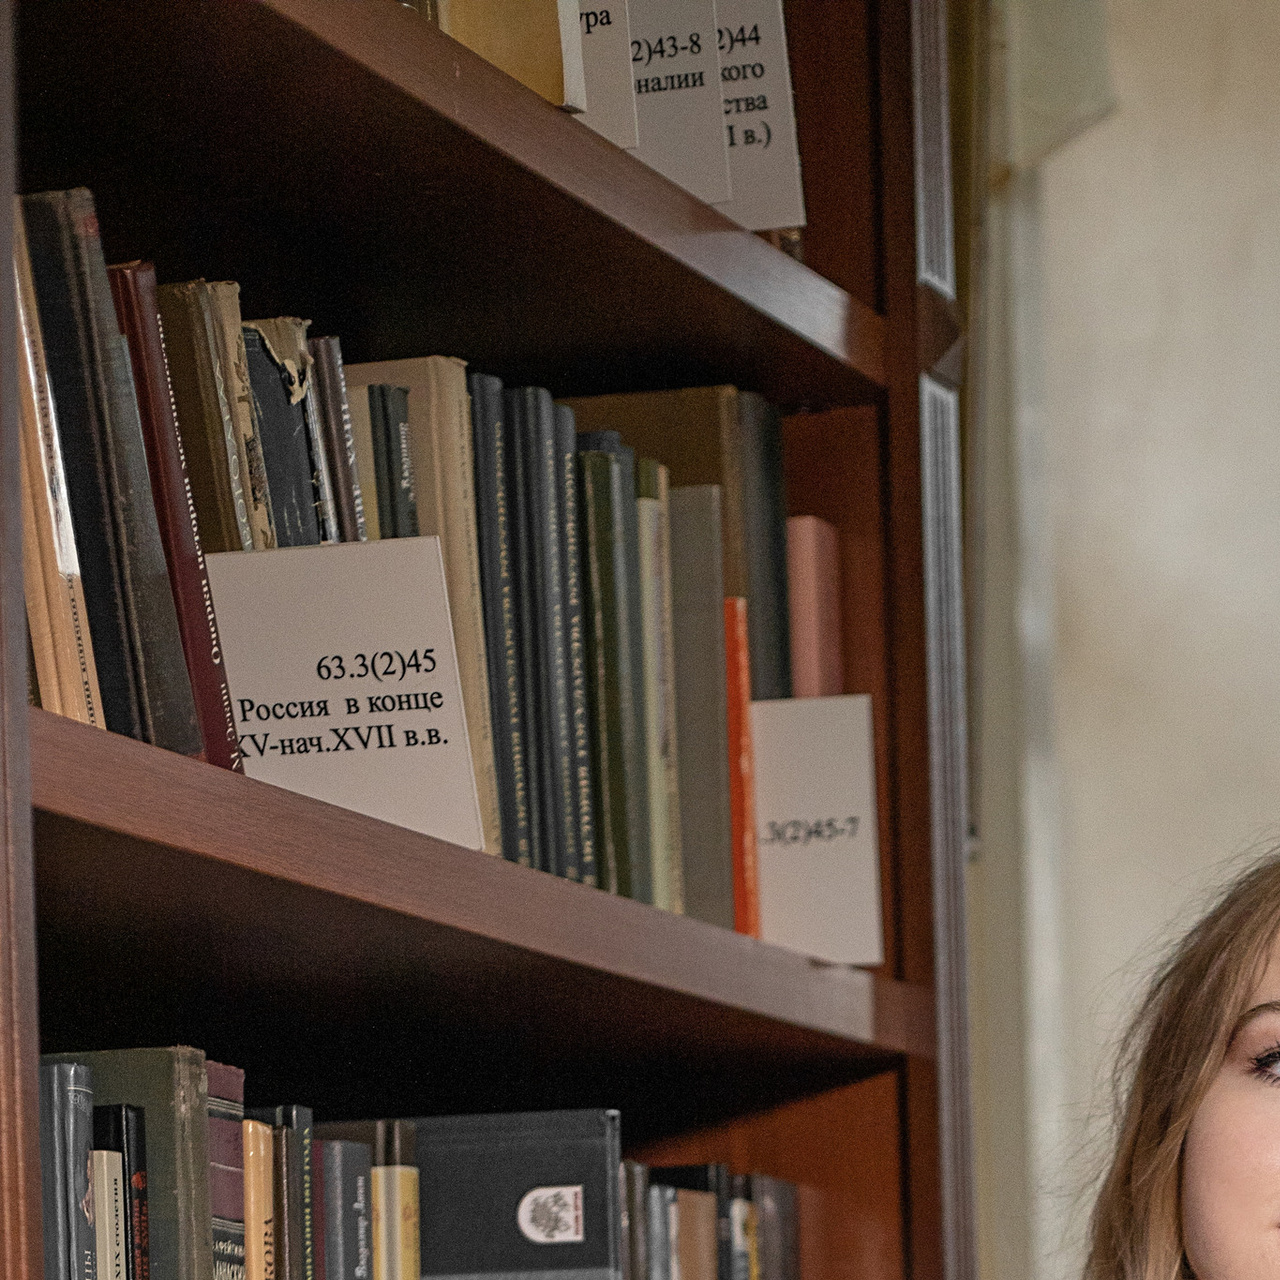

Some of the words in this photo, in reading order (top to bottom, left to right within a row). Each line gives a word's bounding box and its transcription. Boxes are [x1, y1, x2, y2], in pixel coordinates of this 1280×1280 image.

[580, 8, 612, 34] ра
[635, 71, 705, 94] налии
[183, 477, 205, 569] истории
[202, 579, 222, 665] Очерки
[316, 648, 437, 682] 63.3(2)45
[237, 698, 330, 723] Россия
[345, 698, 360, 715] в
[367, 690, 444, 713] конце
[403, 727, 449, 747] в.в.
[302, 1128, 310, 1170] ГОДА
